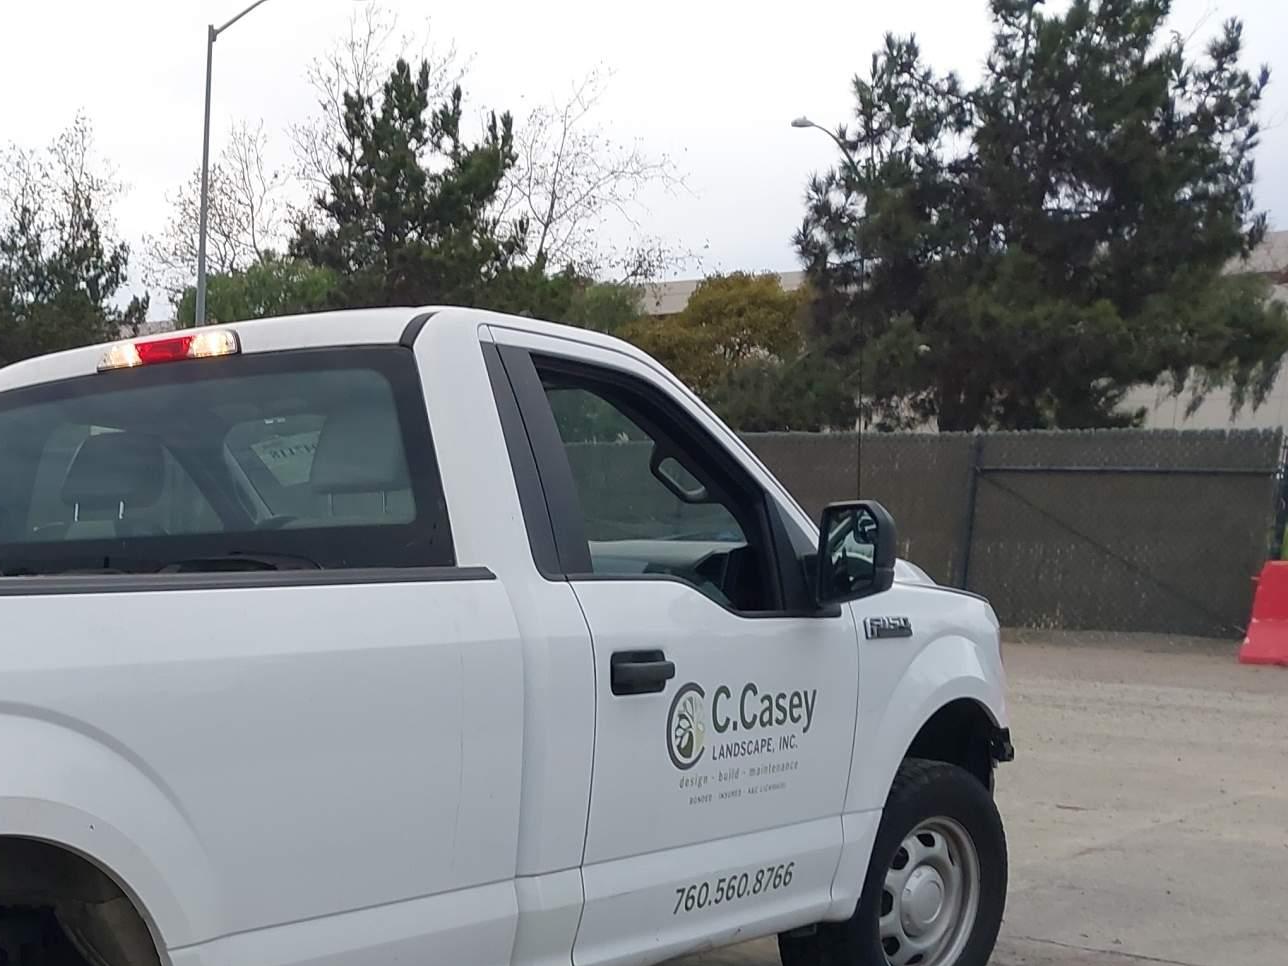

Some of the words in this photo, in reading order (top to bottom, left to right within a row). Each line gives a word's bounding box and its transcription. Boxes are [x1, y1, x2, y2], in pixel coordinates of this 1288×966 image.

[712, 682, 817, 733] C.Casey
[712, 737, 775, 760] LANDSCAPE,
[779, 734, 798, 751] INC.
[679, 774, 708, 788] design
[718, 767, 740, 782] build
[749, 760, 799, 776] maintenance
[673, 861, 794, 914] 760.560.8766
